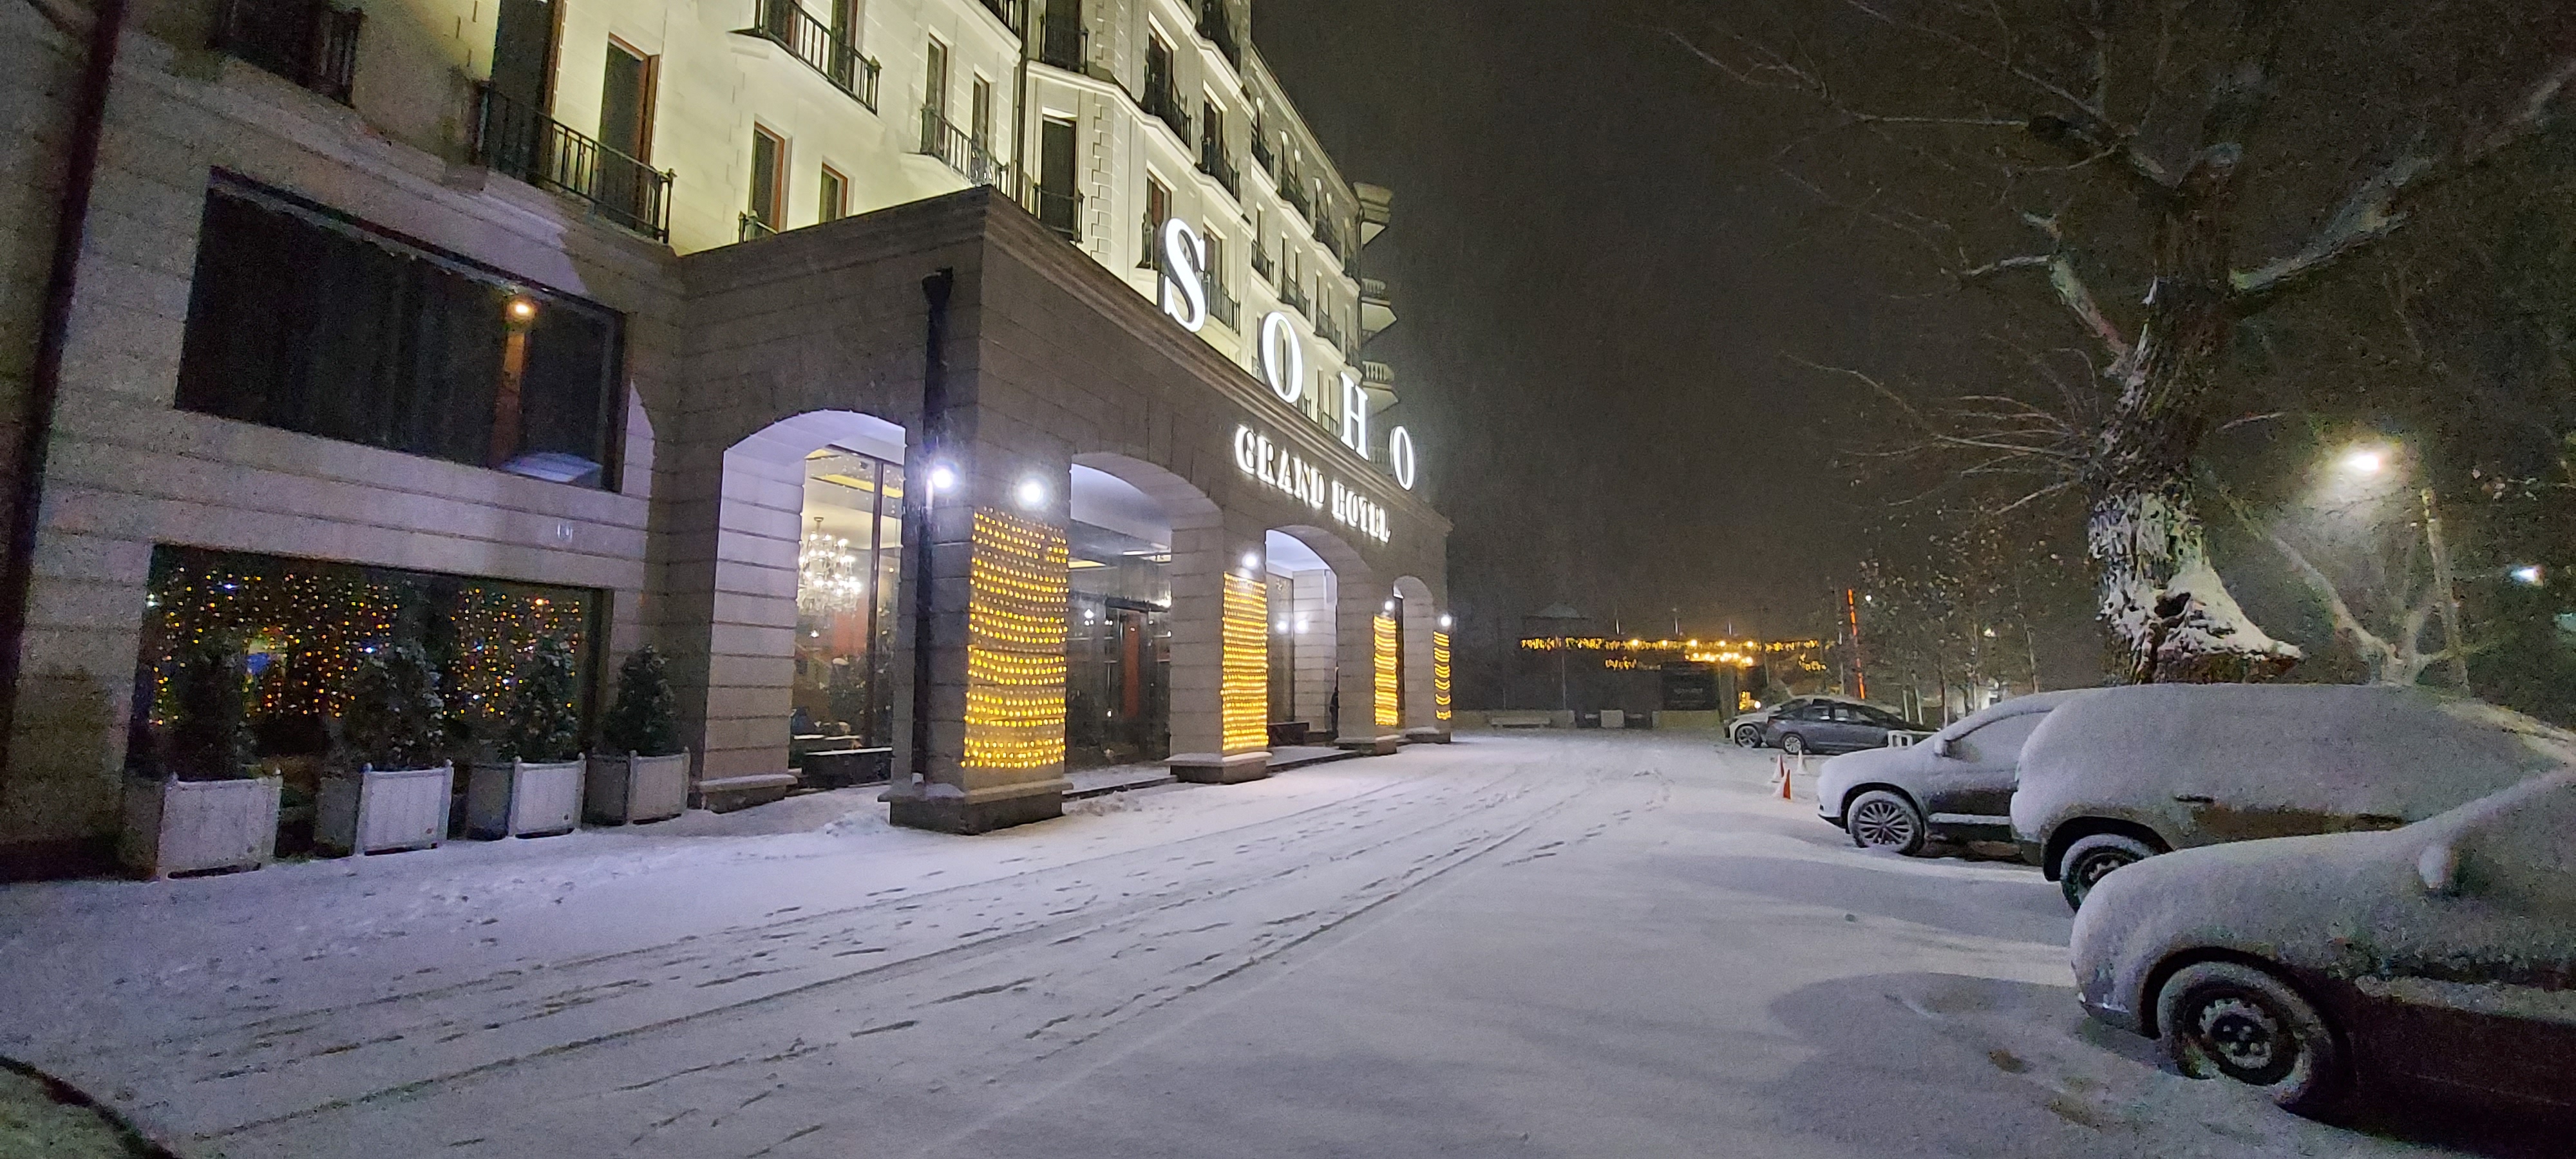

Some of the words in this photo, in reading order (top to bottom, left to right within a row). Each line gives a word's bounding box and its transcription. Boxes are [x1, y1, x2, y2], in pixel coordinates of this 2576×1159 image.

[1162, 217, 1415, 491] SOHO
[1234, 425, 1326, 509] GRAND
[1331, 480, 1392, 544] HOTEL
